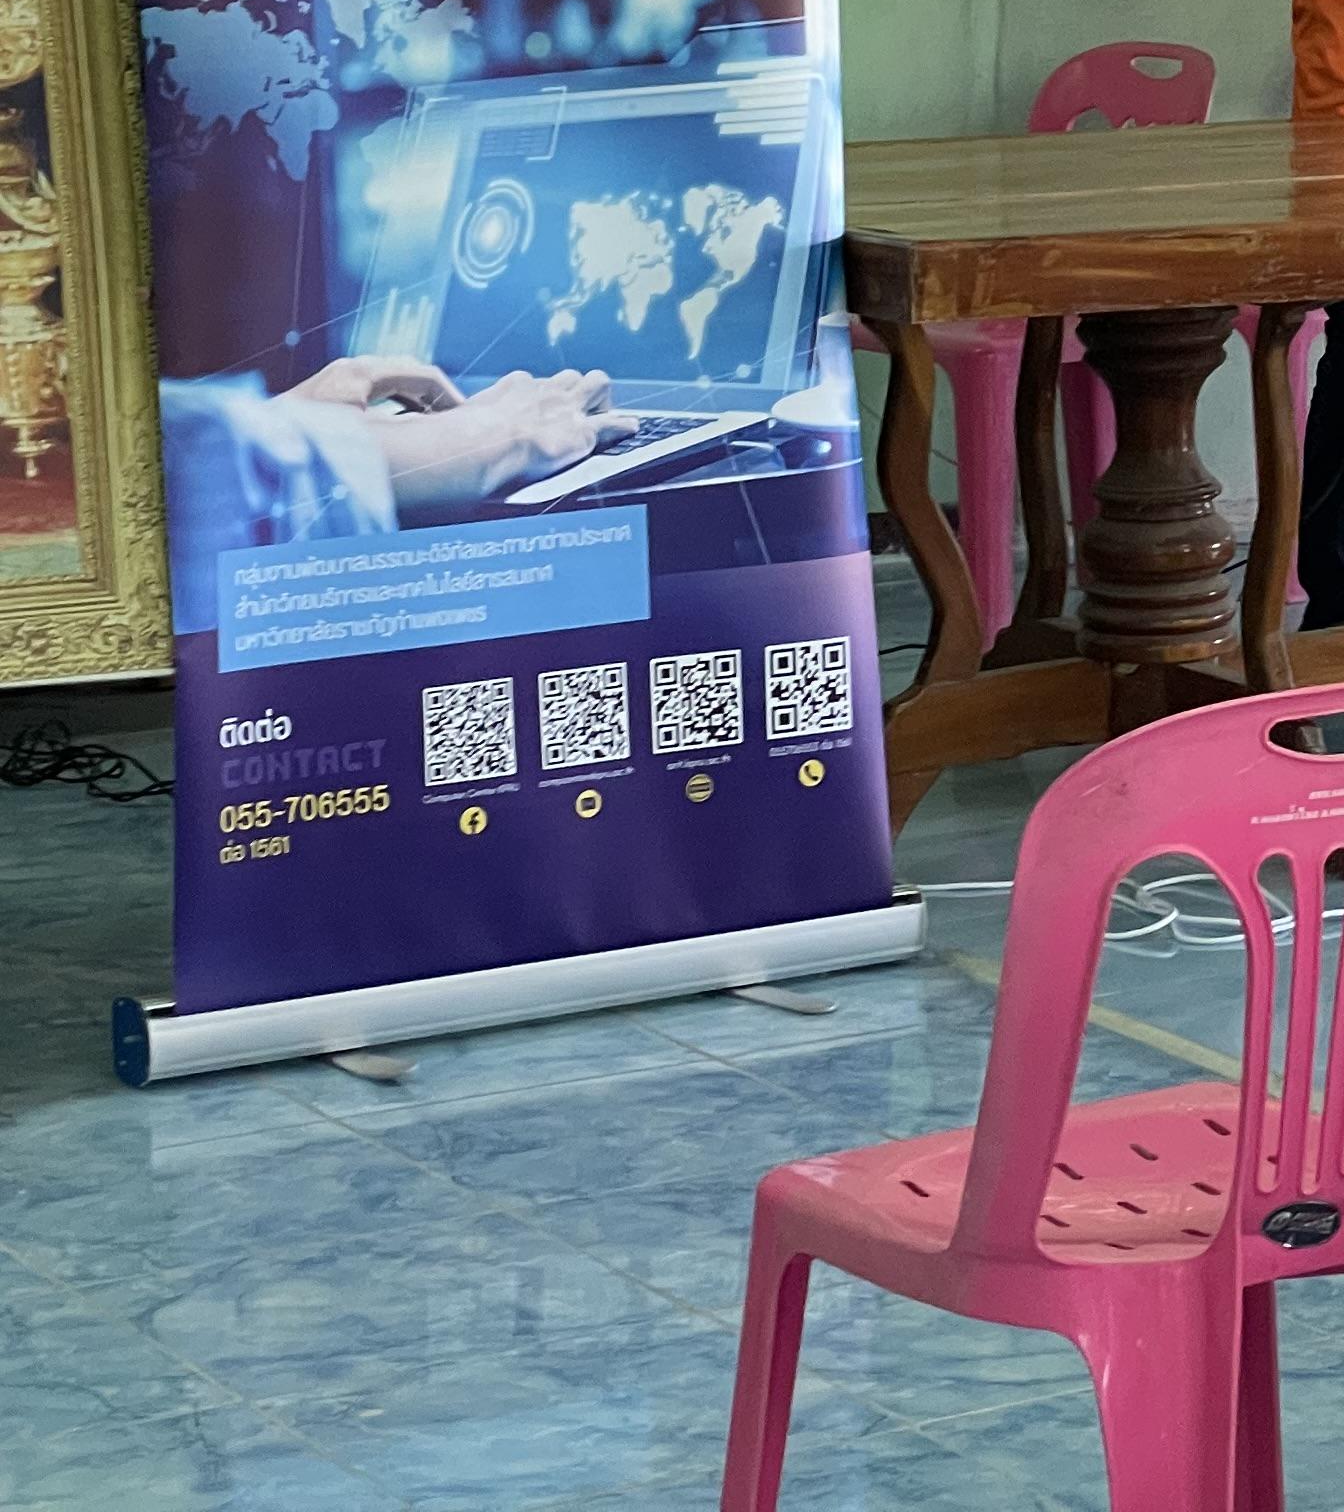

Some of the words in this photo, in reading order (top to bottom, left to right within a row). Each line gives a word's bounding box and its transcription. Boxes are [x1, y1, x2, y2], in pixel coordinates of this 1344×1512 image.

[219, 709, 292, 748] ติดต่อ
[222, 739, 387, 789] CONTACT
[219, 785, 391, 833] 055-706555
[219, 839, 246, 864] ต่อ
[250, 835, 291, 860] 1561
